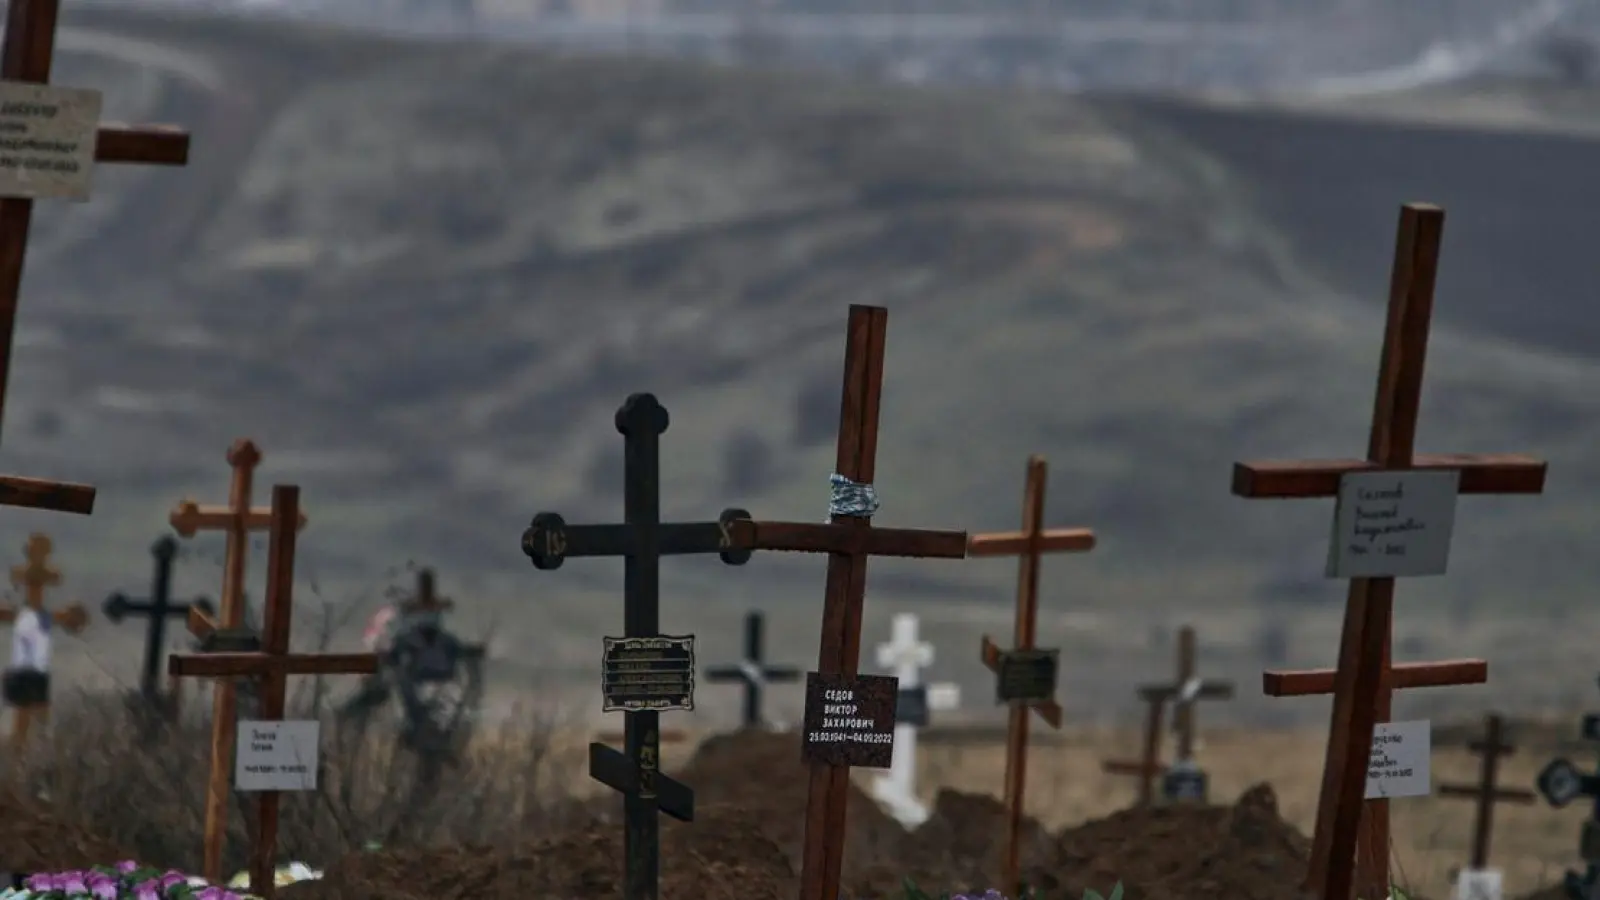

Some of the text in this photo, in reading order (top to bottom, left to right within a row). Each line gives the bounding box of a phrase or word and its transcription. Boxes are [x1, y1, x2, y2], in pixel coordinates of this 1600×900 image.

[825, 690, 853, 702] СЕДОВ
[824, 704, 857, 715] ВИКТОР
[822, 718, 874, 728] ЗАХАРОВИЧ
